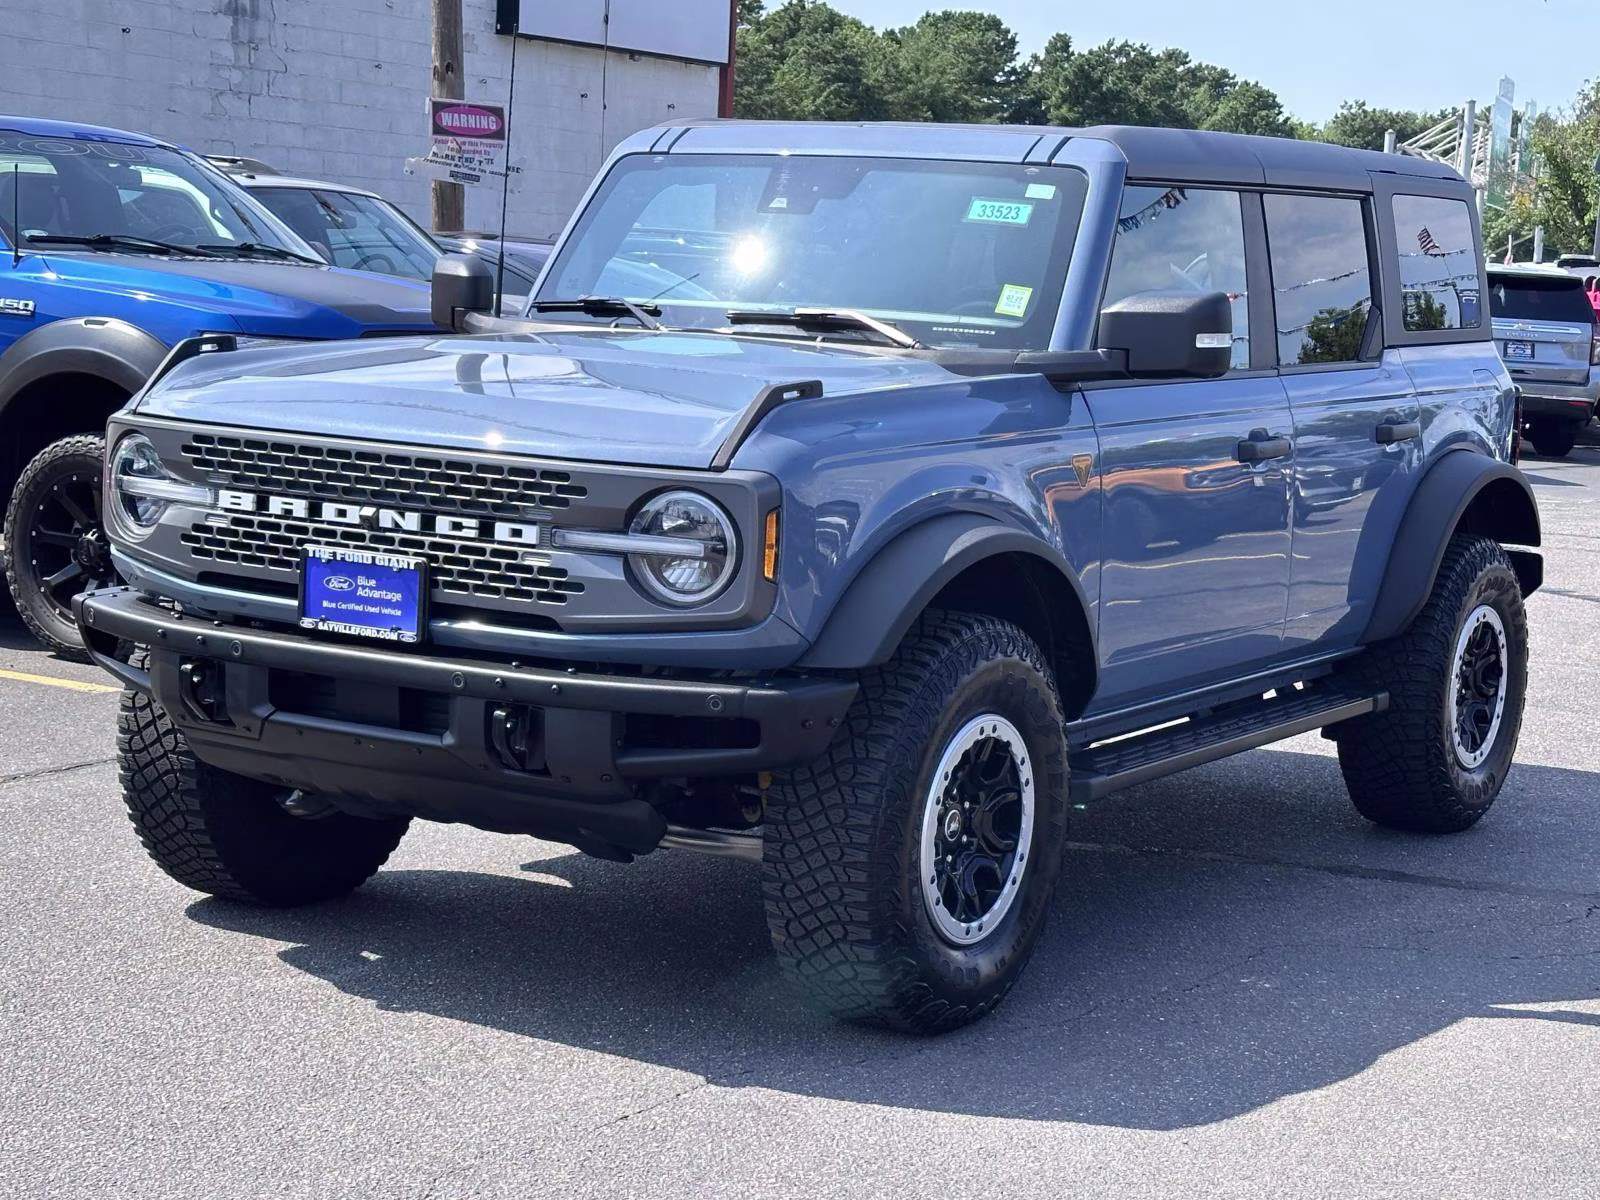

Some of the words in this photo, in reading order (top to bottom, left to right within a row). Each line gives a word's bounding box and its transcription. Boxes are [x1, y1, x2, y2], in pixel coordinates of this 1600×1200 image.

[441, 112, 497, 130] WARNING
[977, 204, 1021, 220] 33523
[218, 489, 539, 545] BRONCO
[308, 549, 334, 560] THE
[336, 552, 372, 564] FORD
[375, 557, 415, 570] GIANT
[357, 575, 376, 587] Blue
[356, 586, 402, 602] Advantage
[322, 600, 336, 608] Blue
[337, 601, 363, 611] Certified
[364, 604, 380, 613] Used
[380, 606, 402, 616] Vehicle
[318, 622, 398, 641] SAYVILLEFORD.COM
